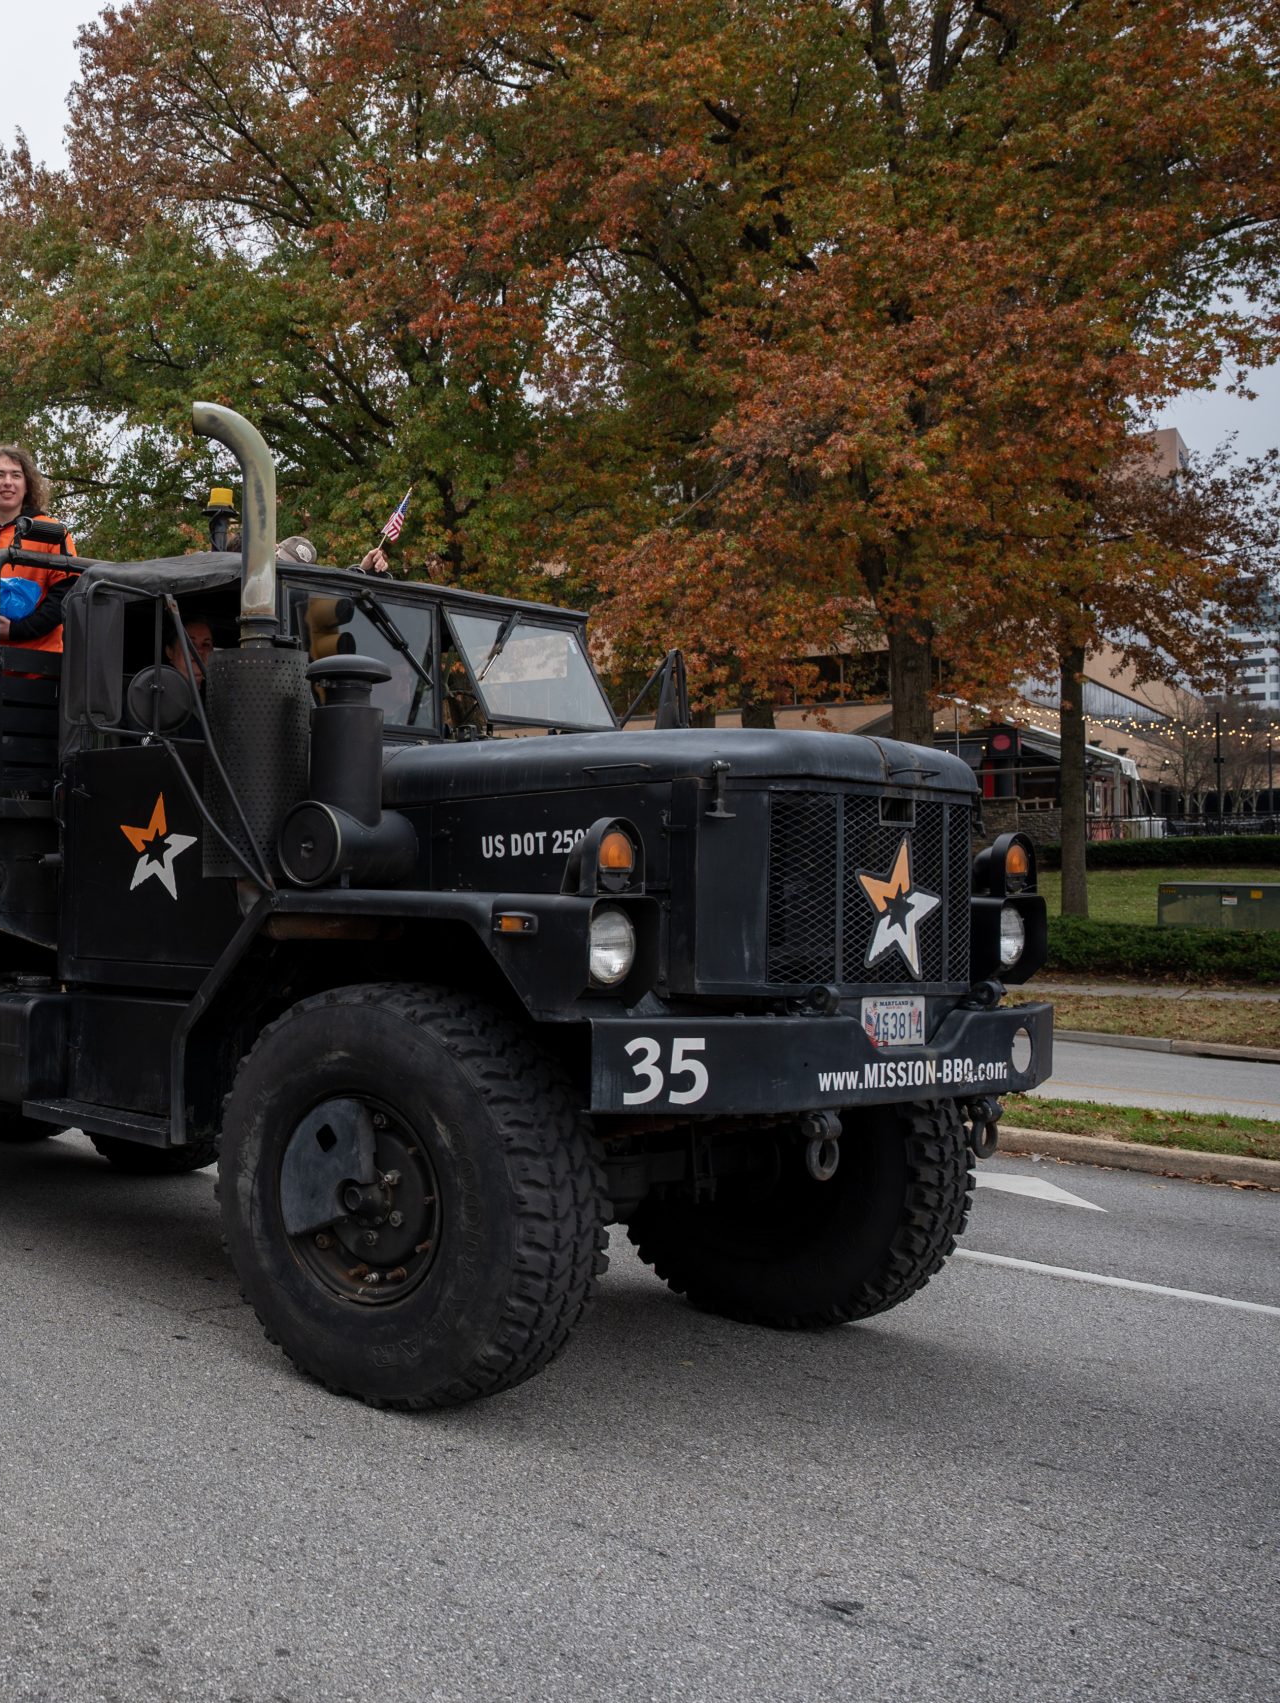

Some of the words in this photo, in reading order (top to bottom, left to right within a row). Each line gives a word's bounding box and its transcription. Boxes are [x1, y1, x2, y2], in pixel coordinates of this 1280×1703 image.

[481, 834, 506, 859] US
[510, 831, 547, 856] DOT
[551, 828, 590, 854] 250
[622, 1036, 710, 1106] 35
[818, 1057, 1008, 1092] www.MISSION-BBQ.com
